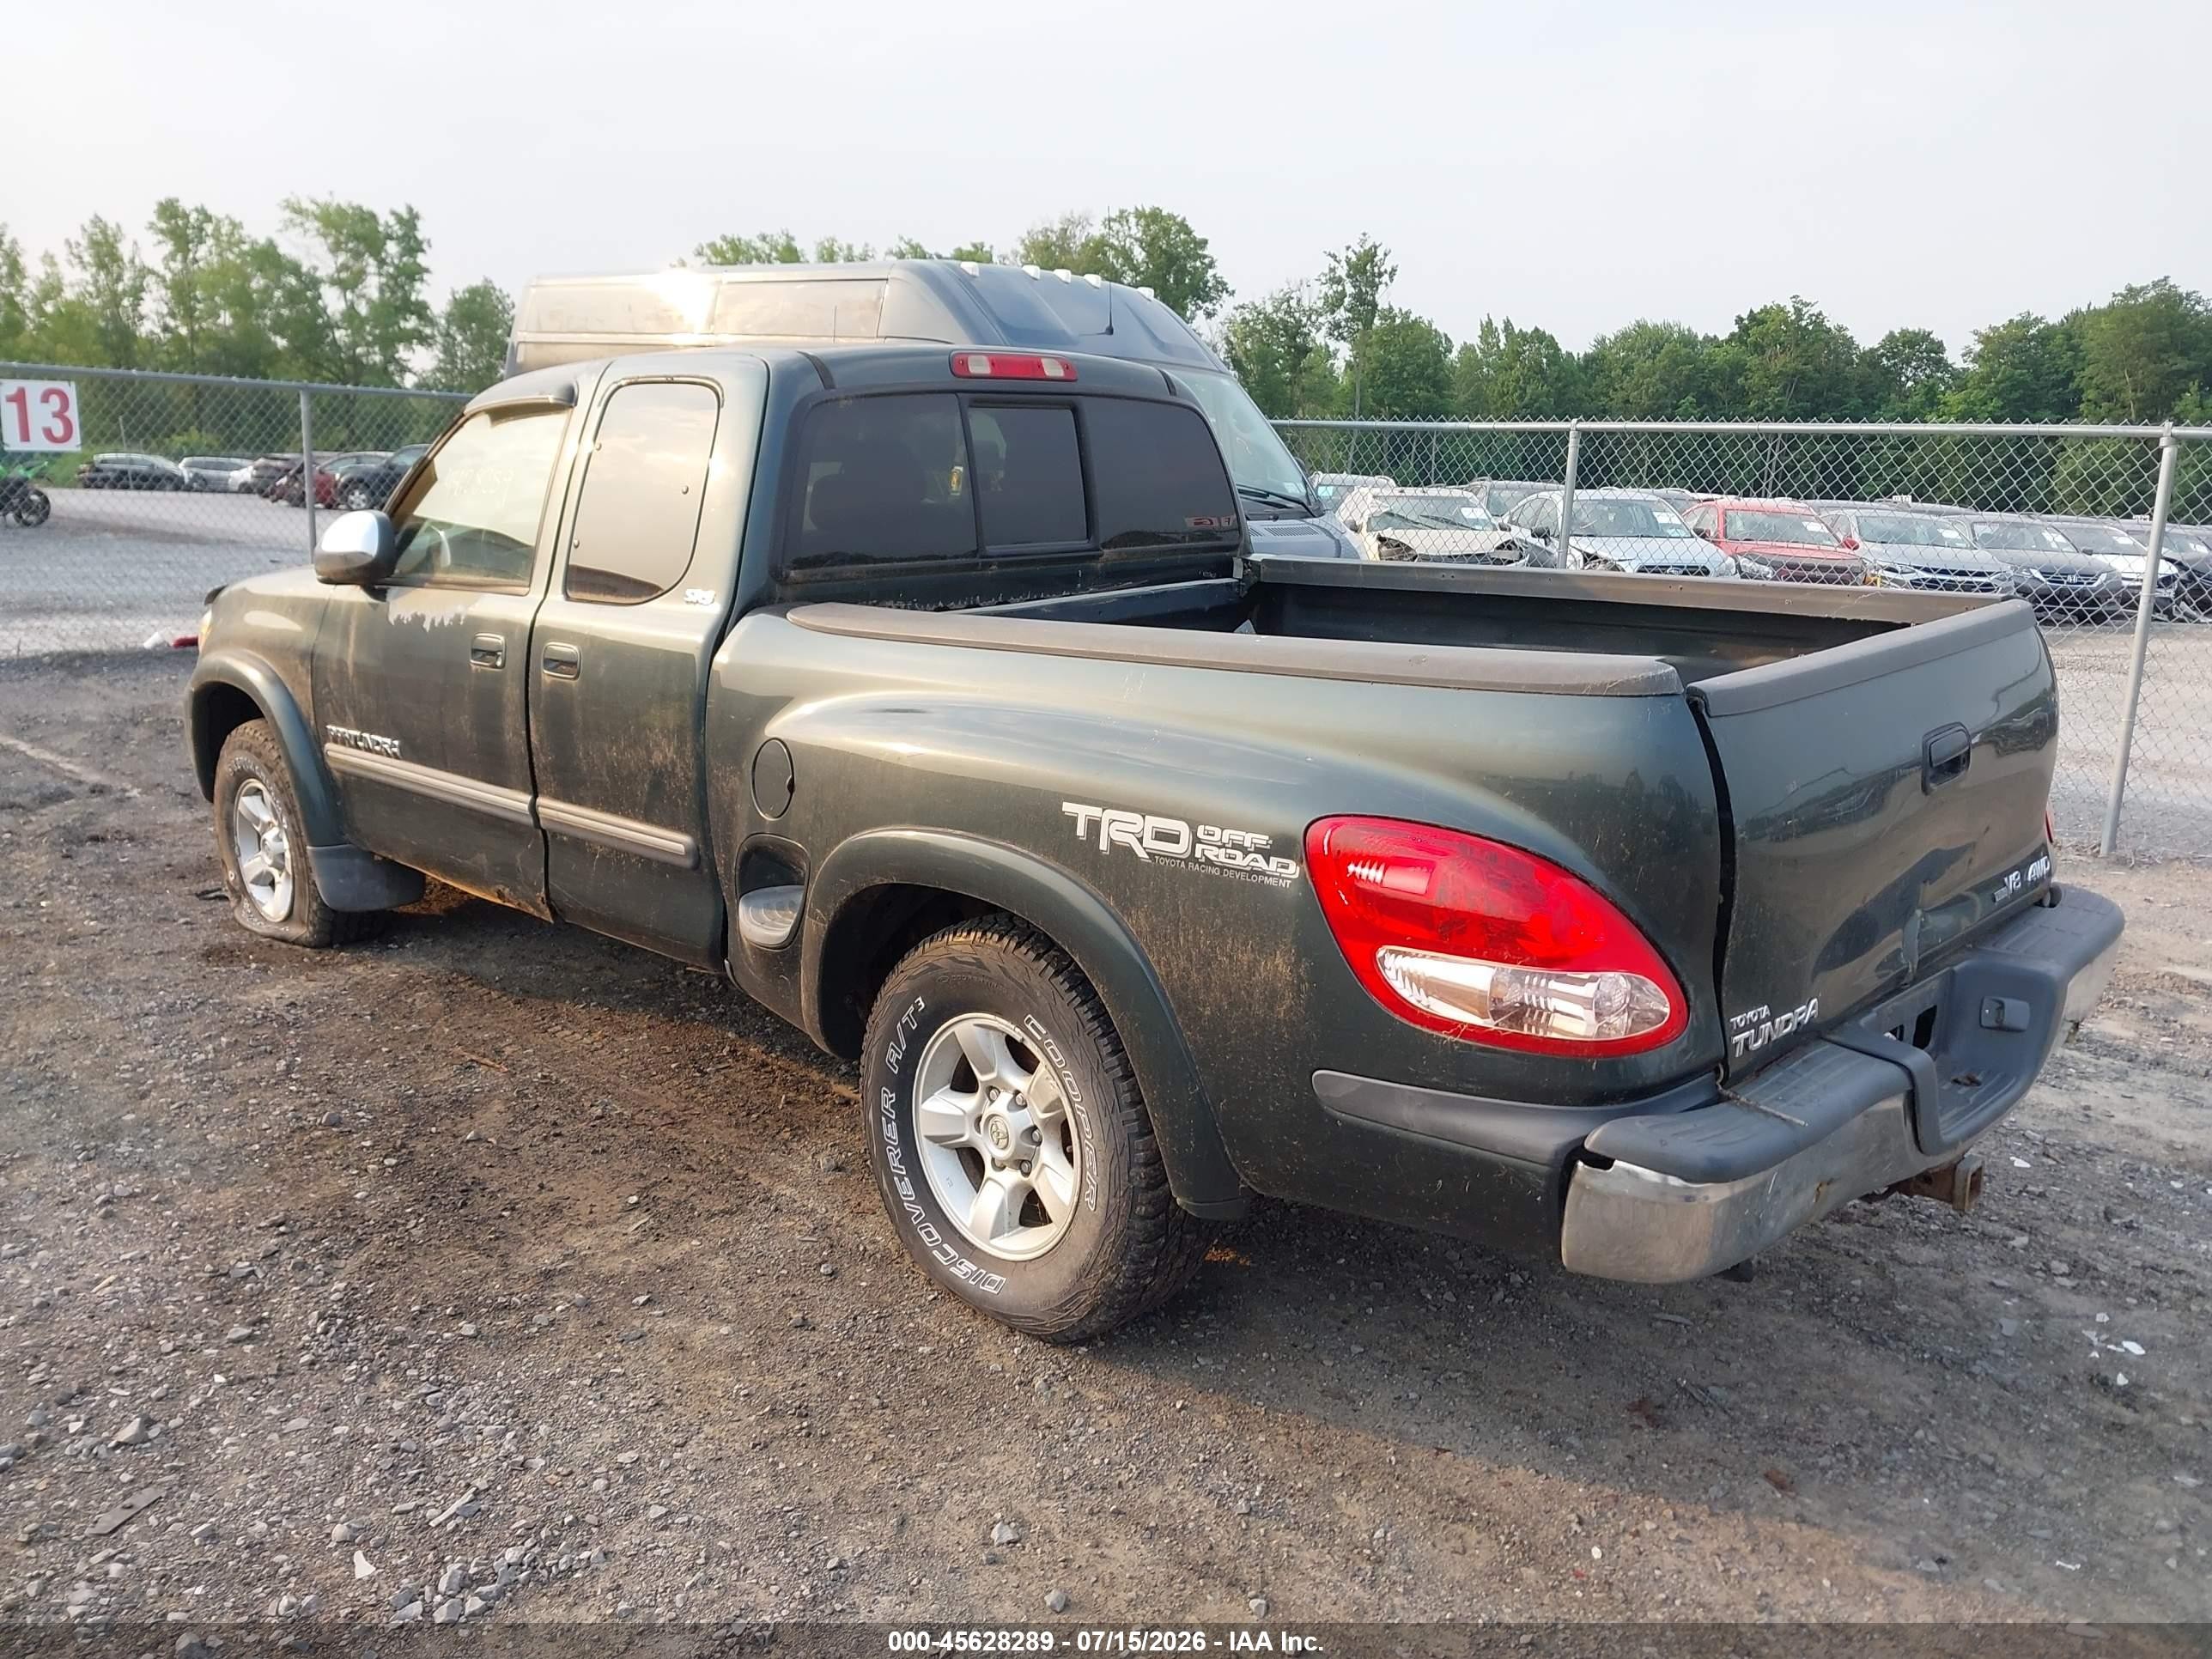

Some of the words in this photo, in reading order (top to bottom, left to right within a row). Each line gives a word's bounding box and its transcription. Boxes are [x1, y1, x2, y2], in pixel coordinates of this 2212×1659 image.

[5, 386, 74, 443] 13
[1062, 801, 1192, 863] TRD
[1194, 842, 1300, 879] ROAD
[1196, 823, 1273, 851] OFF
[1154, 855, 1186, 870] TOYOTA
[1188, 861, 1220, 876] RACING
[1222, 868, 1292, 888] DEVELOPMENT
[1730, 1005, 1771, 1030] TOYOTA
[1731, 997, 1820, 1058] TUNDRA
[1024, 1014, 1098, 1212] COOPER
[881, 1086, 1008, 1296] DISCOVERER
